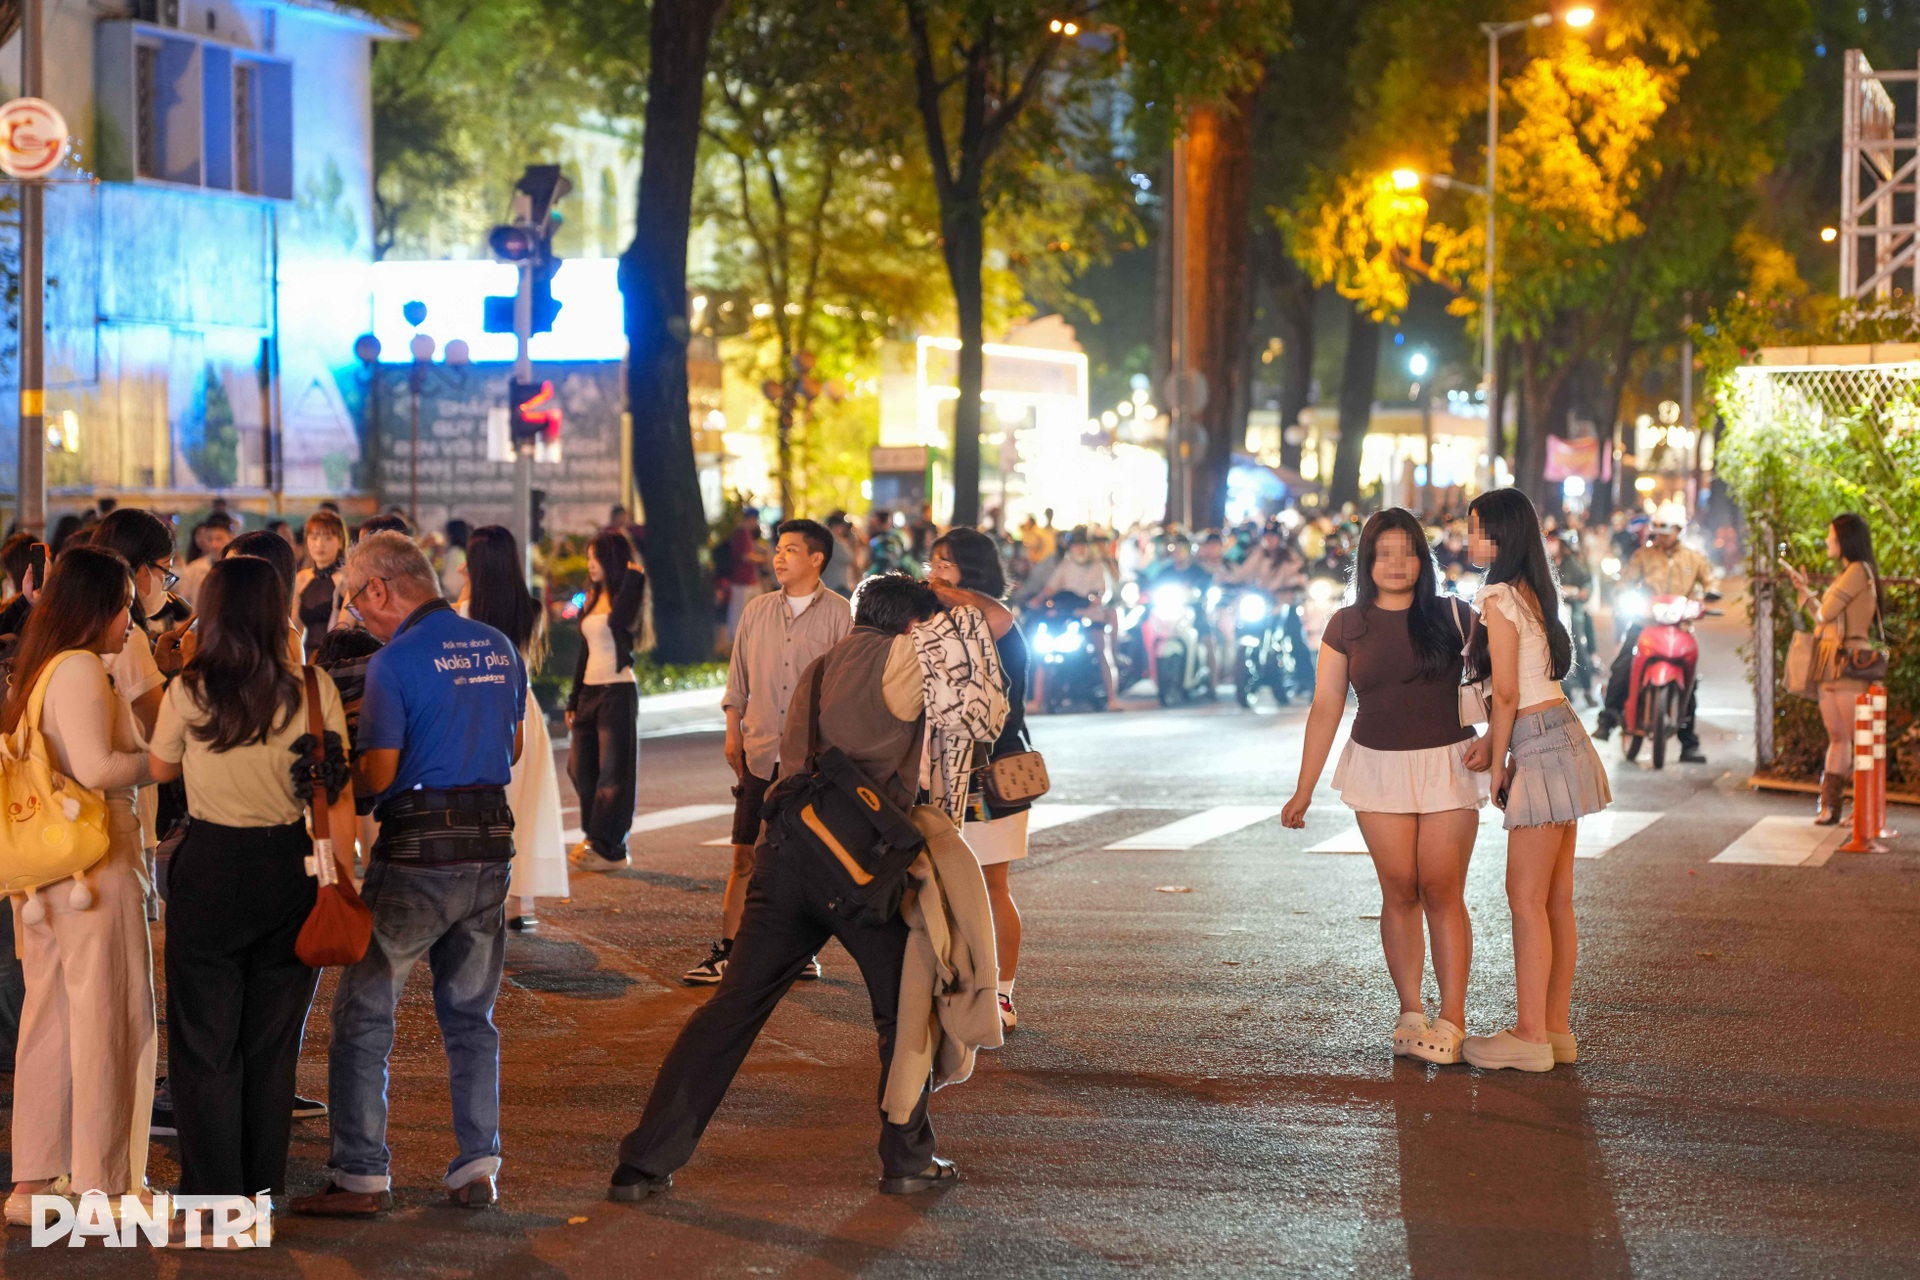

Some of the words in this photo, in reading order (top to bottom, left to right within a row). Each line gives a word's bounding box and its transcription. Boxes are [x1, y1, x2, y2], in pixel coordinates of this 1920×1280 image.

[442, 641, 456, 649] Ask
[456, 641, 468, 649] me
[469, 639, 491, 648] about
[434, 655, 471, 672] Nokia
[472, 653, 480, 667] 7
[485, 651, 510, 670] plus
